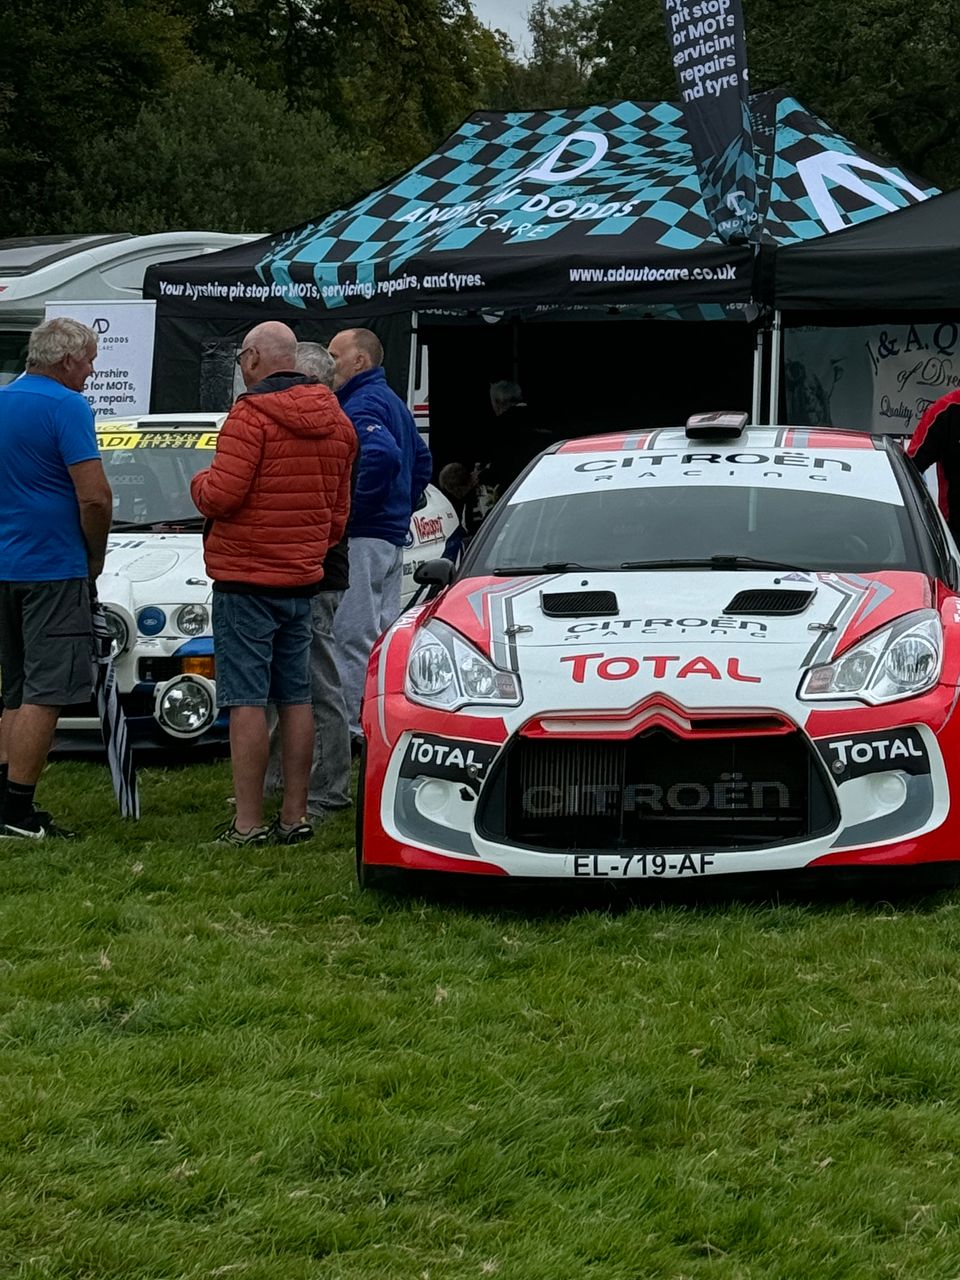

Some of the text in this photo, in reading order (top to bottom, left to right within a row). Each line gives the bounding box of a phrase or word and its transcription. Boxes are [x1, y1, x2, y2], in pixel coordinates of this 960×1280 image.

[671, 6, 691, 32] pit
[672, 30, 687, 47] or
[682, 72, 739, 103] nd tyre
[520, 194, 641, 220] DODDS
[569, 264, 737, 282] www.adautocare.co.uk
[159, 272, 486, 302] Your Ayrshire pit stop for MOTs, servicing, repairs, and tyres.
[103, 336, 129, 344] DODDS
[878, 330, 900, 360] &
[904, 324, 929, 353] A.
[90, 381, 103, 390] for
[106, 381, 136, 392] MOTs,
[896, 359, 926, 392] of
[93, 407, 117, 416] yres.
[99, 393, 137, 405] repairs,
[879, 395, 914, 428] Quality
[559, 652, 762, 684] TOTAL
[410, 737, 483, 770] TOTAL
[828, 737, 923, 766] TOTAL
[573, 853, 716, 877] EL-719-AF
